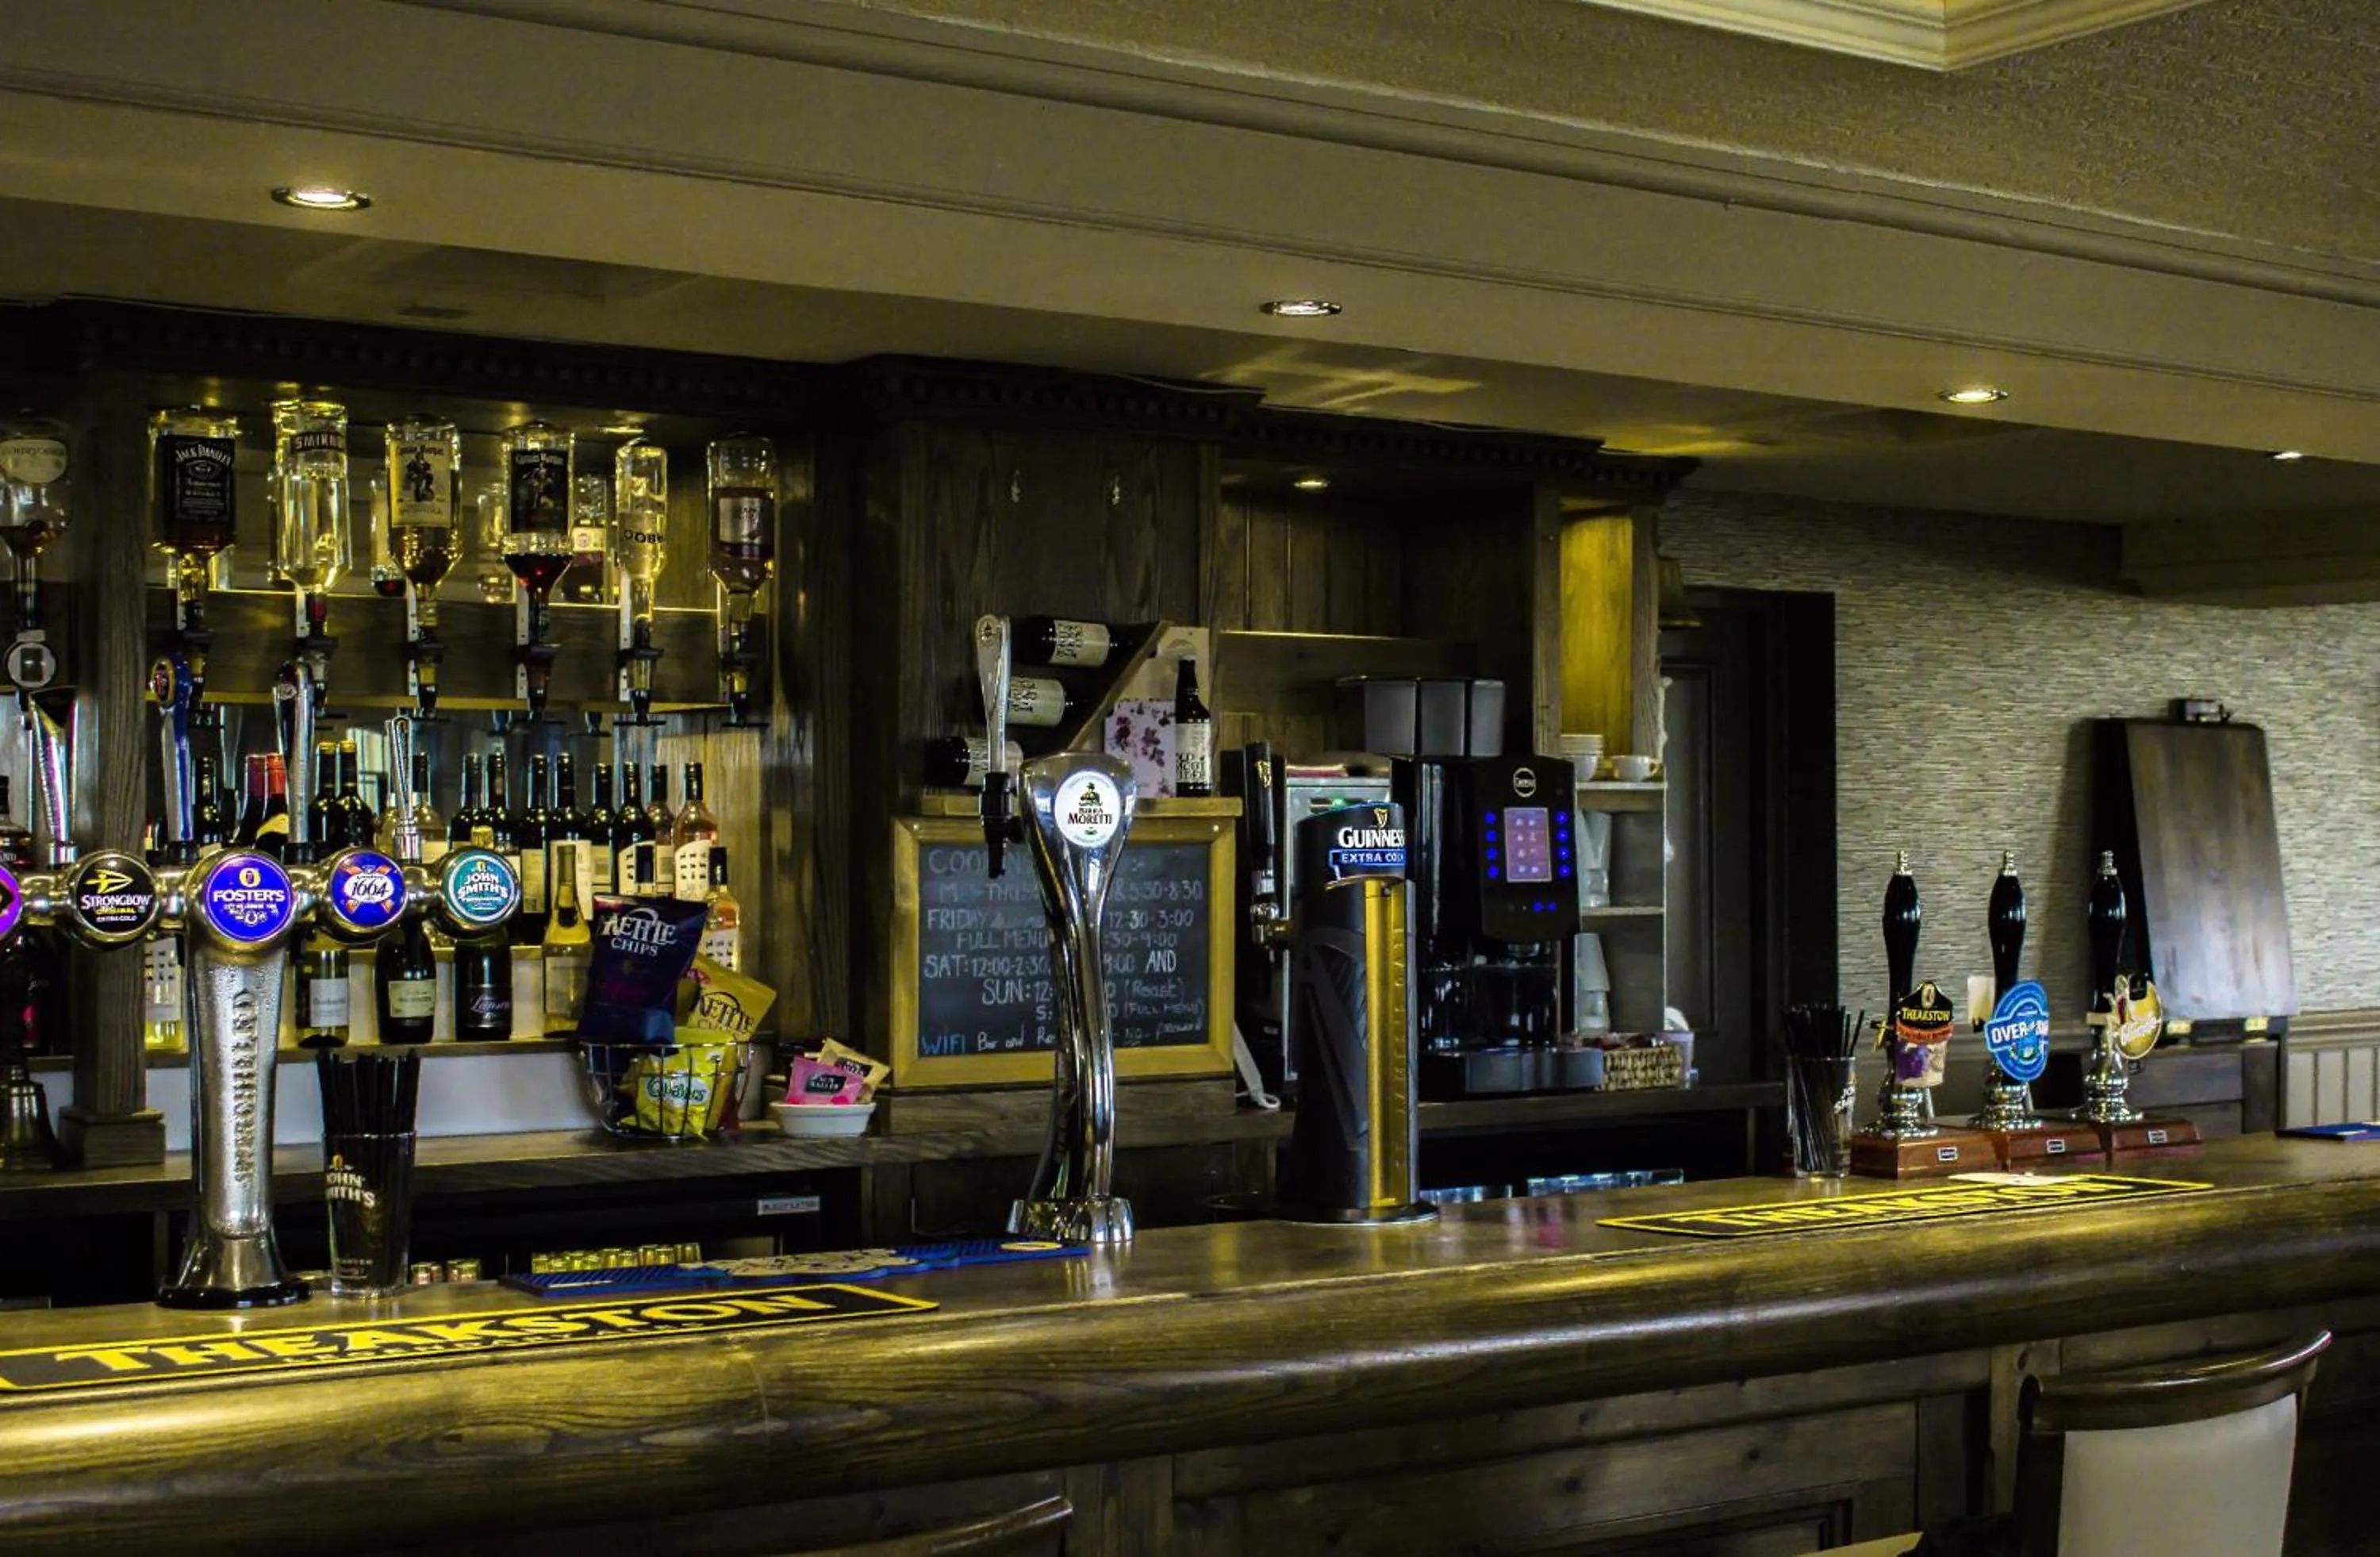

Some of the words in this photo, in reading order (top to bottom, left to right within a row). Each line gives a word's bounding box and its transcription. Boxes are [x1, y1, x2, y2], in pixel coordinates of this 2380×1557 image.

[1068, 813, 1112, 825] MORETTI
[1342, 853, 1383, 863] EXTRA
[464, 872, 500, 885] JOHN
[213, 889, 286, 902] FOSTER'S
[351, 879, 389, 898] 1664
[458, 882, 509, 898] SMITH'S
[80, 894, 153, 910] STRONGBOW
[601, 908, 678, 945] KETTLE
[927, 909, 988, 931] FRIDAY
[610, 937, 660, 957] CHIPS
[956, 932, 1000, 950] FULL
[1004, 929, 1048, 948] MENU
[1144, 950, 1177, 974] AND
[1901, 1006, 1951, 1022] THEAKSTON
[1991, 1021, 2028, 1044] OVER
[921, 1034, 965, 1055] WIFI
[55, 1293, 839, 1372] THEAKSTON
